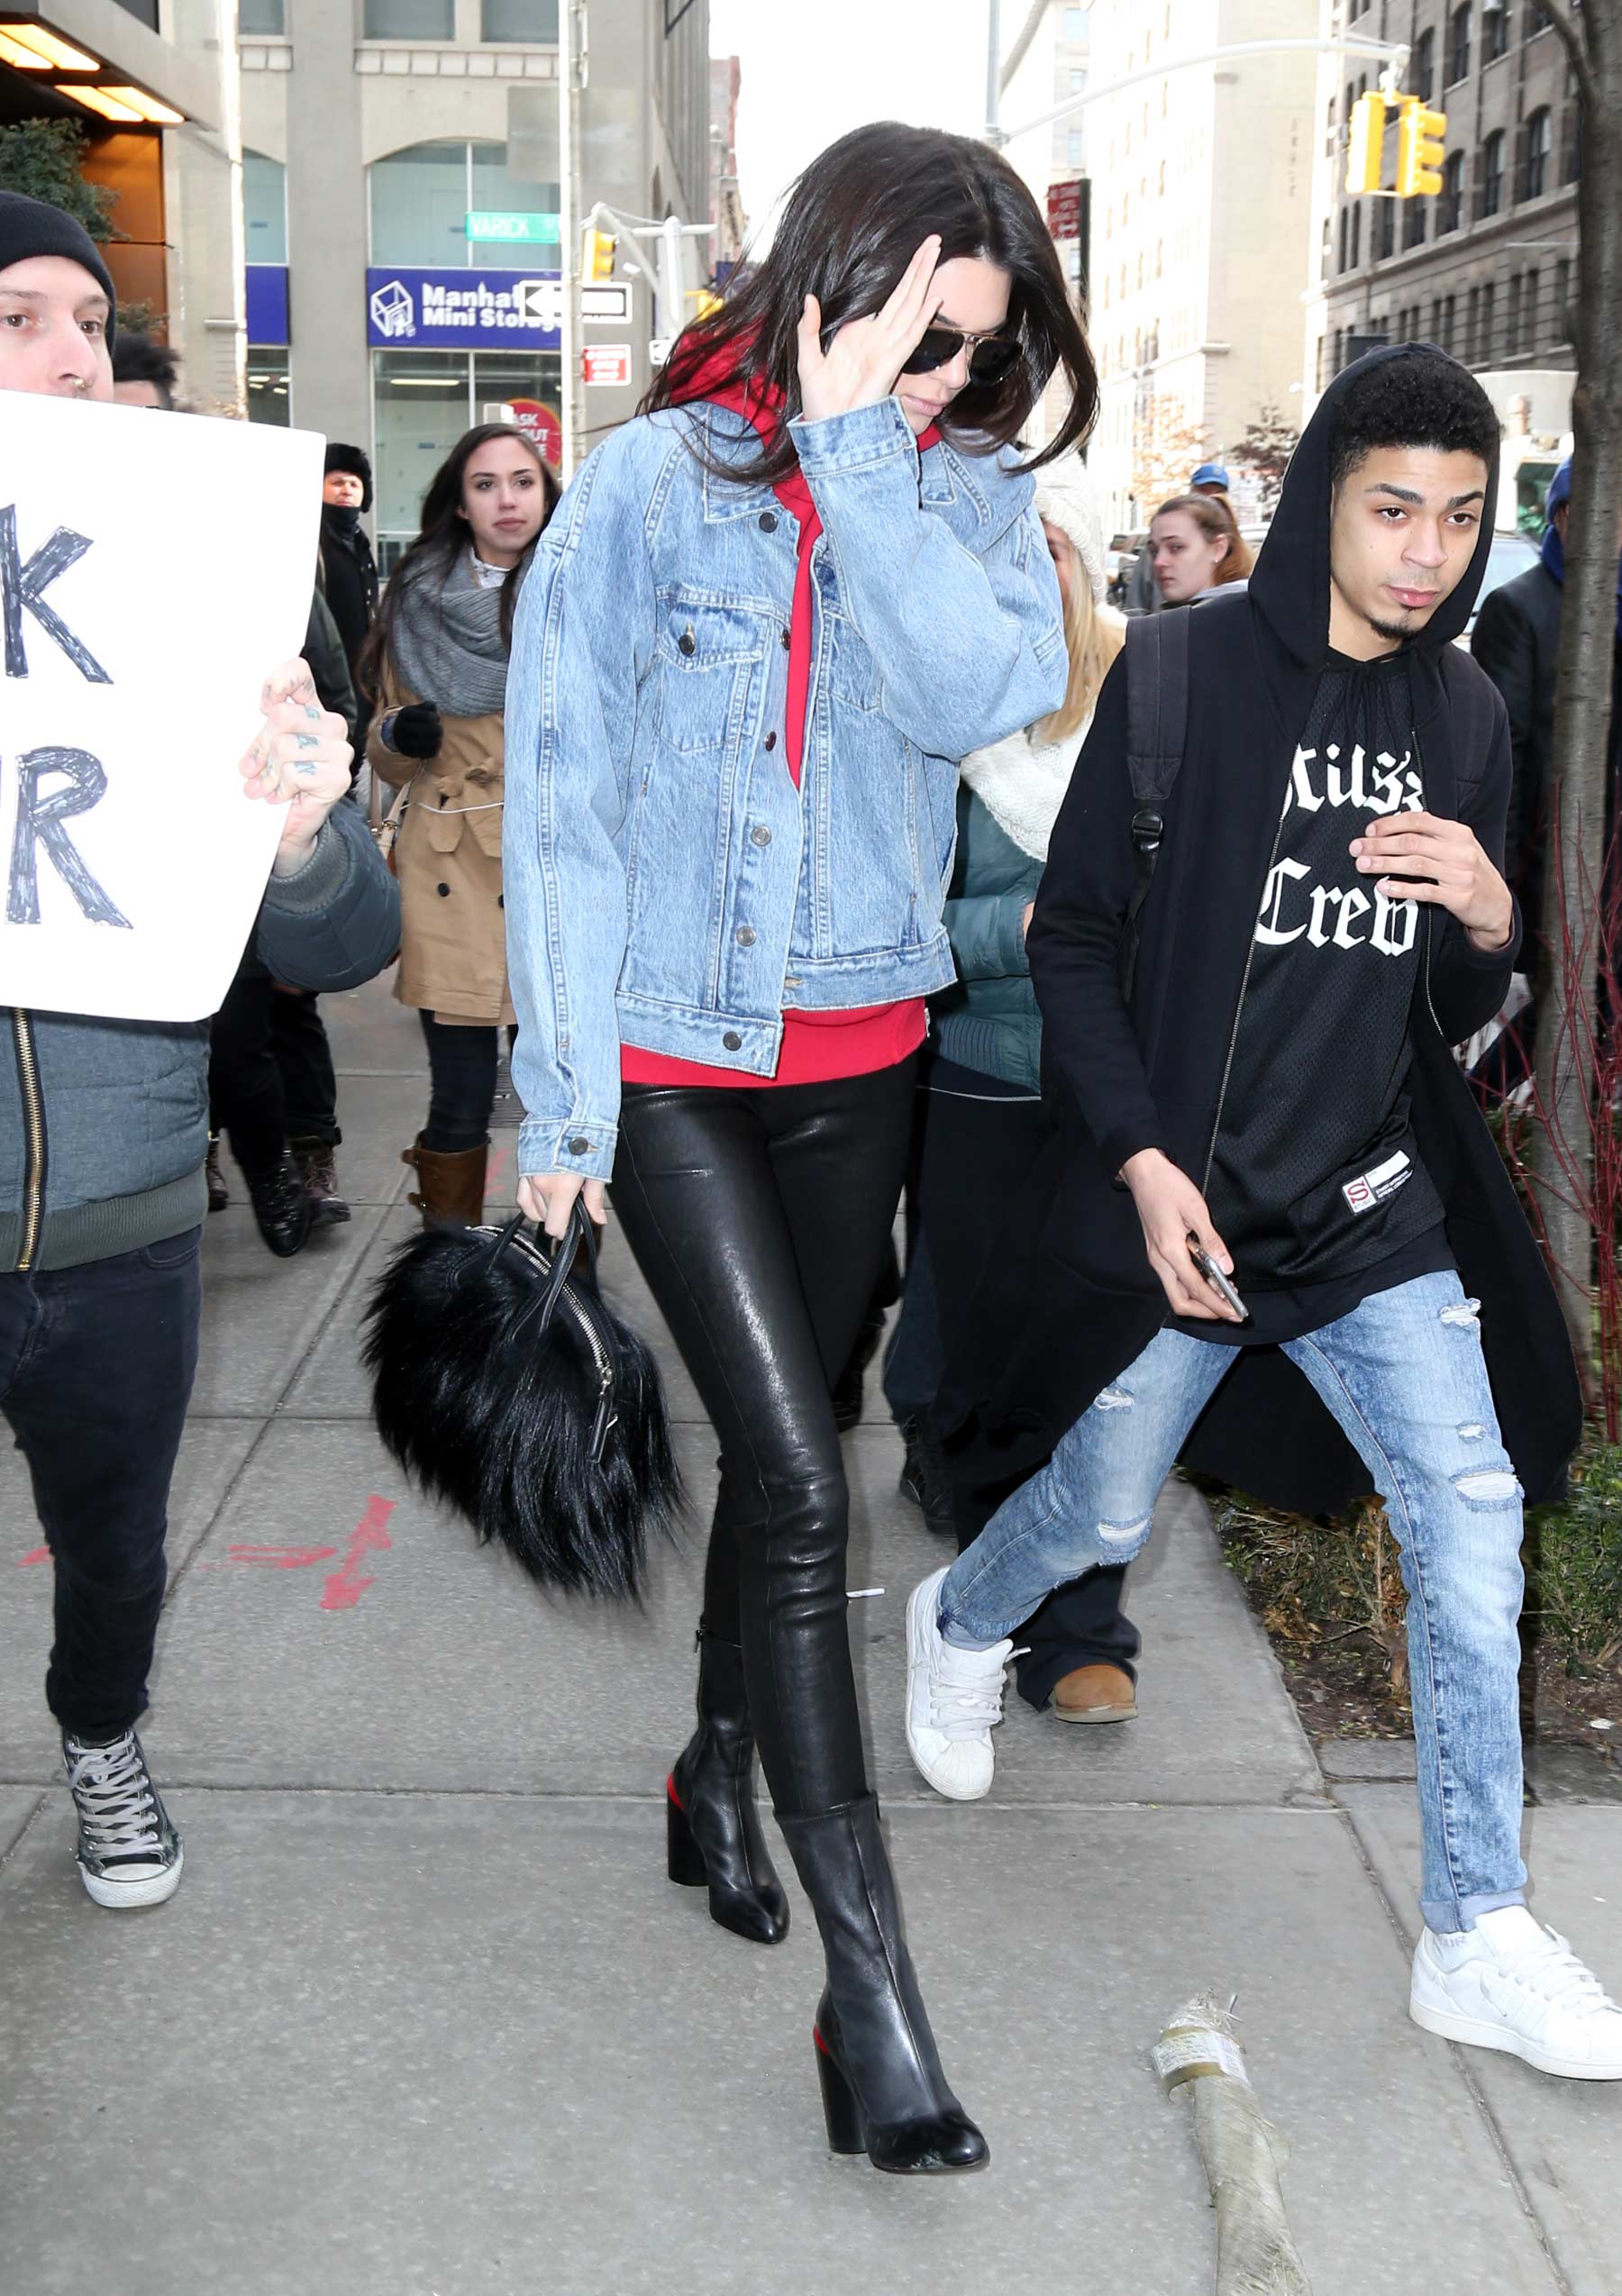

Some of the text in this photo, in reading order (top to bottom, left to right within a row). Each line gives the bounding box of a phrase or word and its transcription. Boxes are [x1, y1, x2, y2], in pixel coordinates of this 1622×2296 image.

[469, 214, 530, 238] VARICK
[423, 306, 476, 326] Mini
[1254, 857, 1419, 957] Crew
